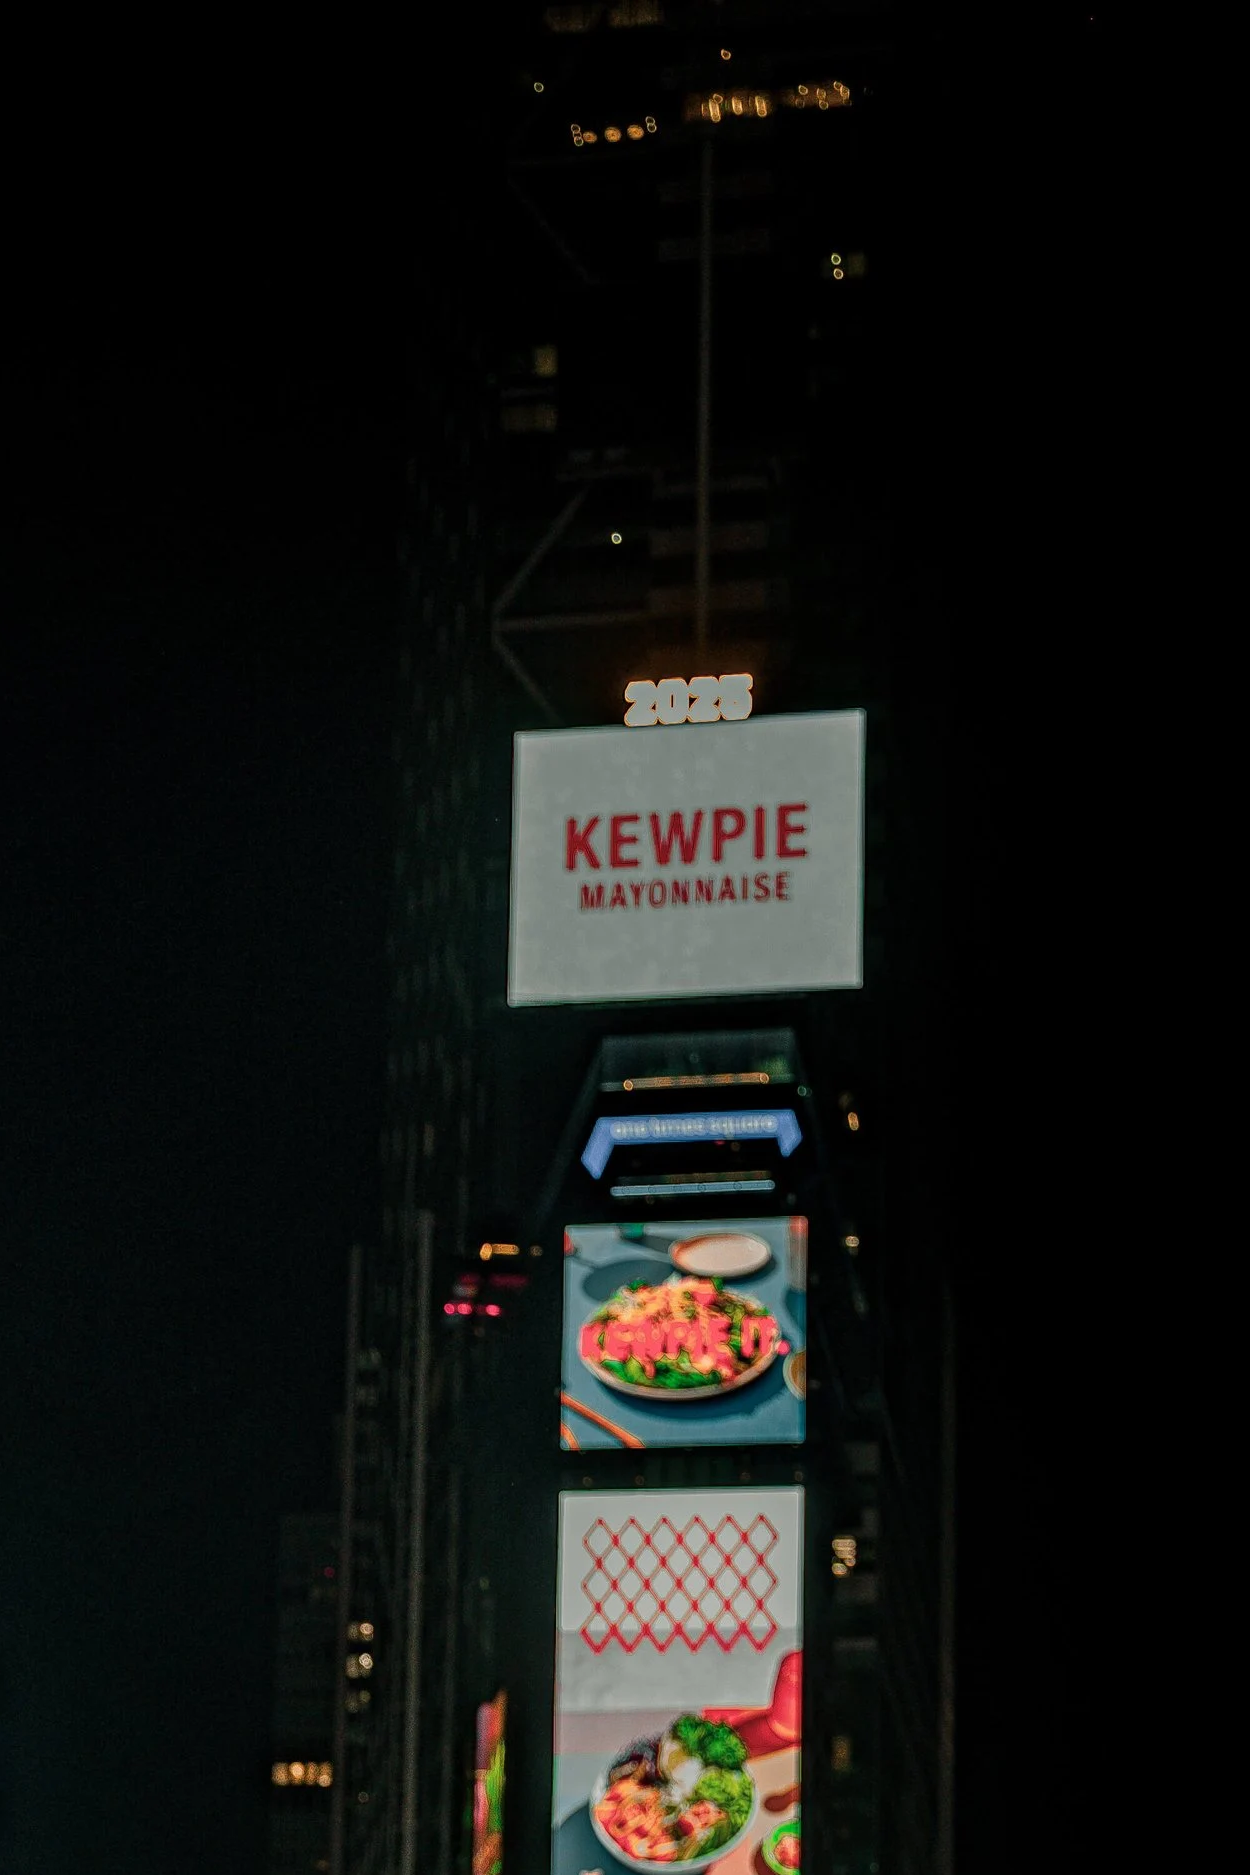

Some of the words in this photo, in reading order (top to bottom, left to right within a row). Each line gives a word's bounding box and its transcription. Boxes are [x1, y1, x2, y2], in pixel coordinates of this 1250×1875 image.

[623, 673, 754, 727] 2025
[563, 801, 810, 873] KEWPIE
[579, 871, 792, 911] MAYONNAISE
